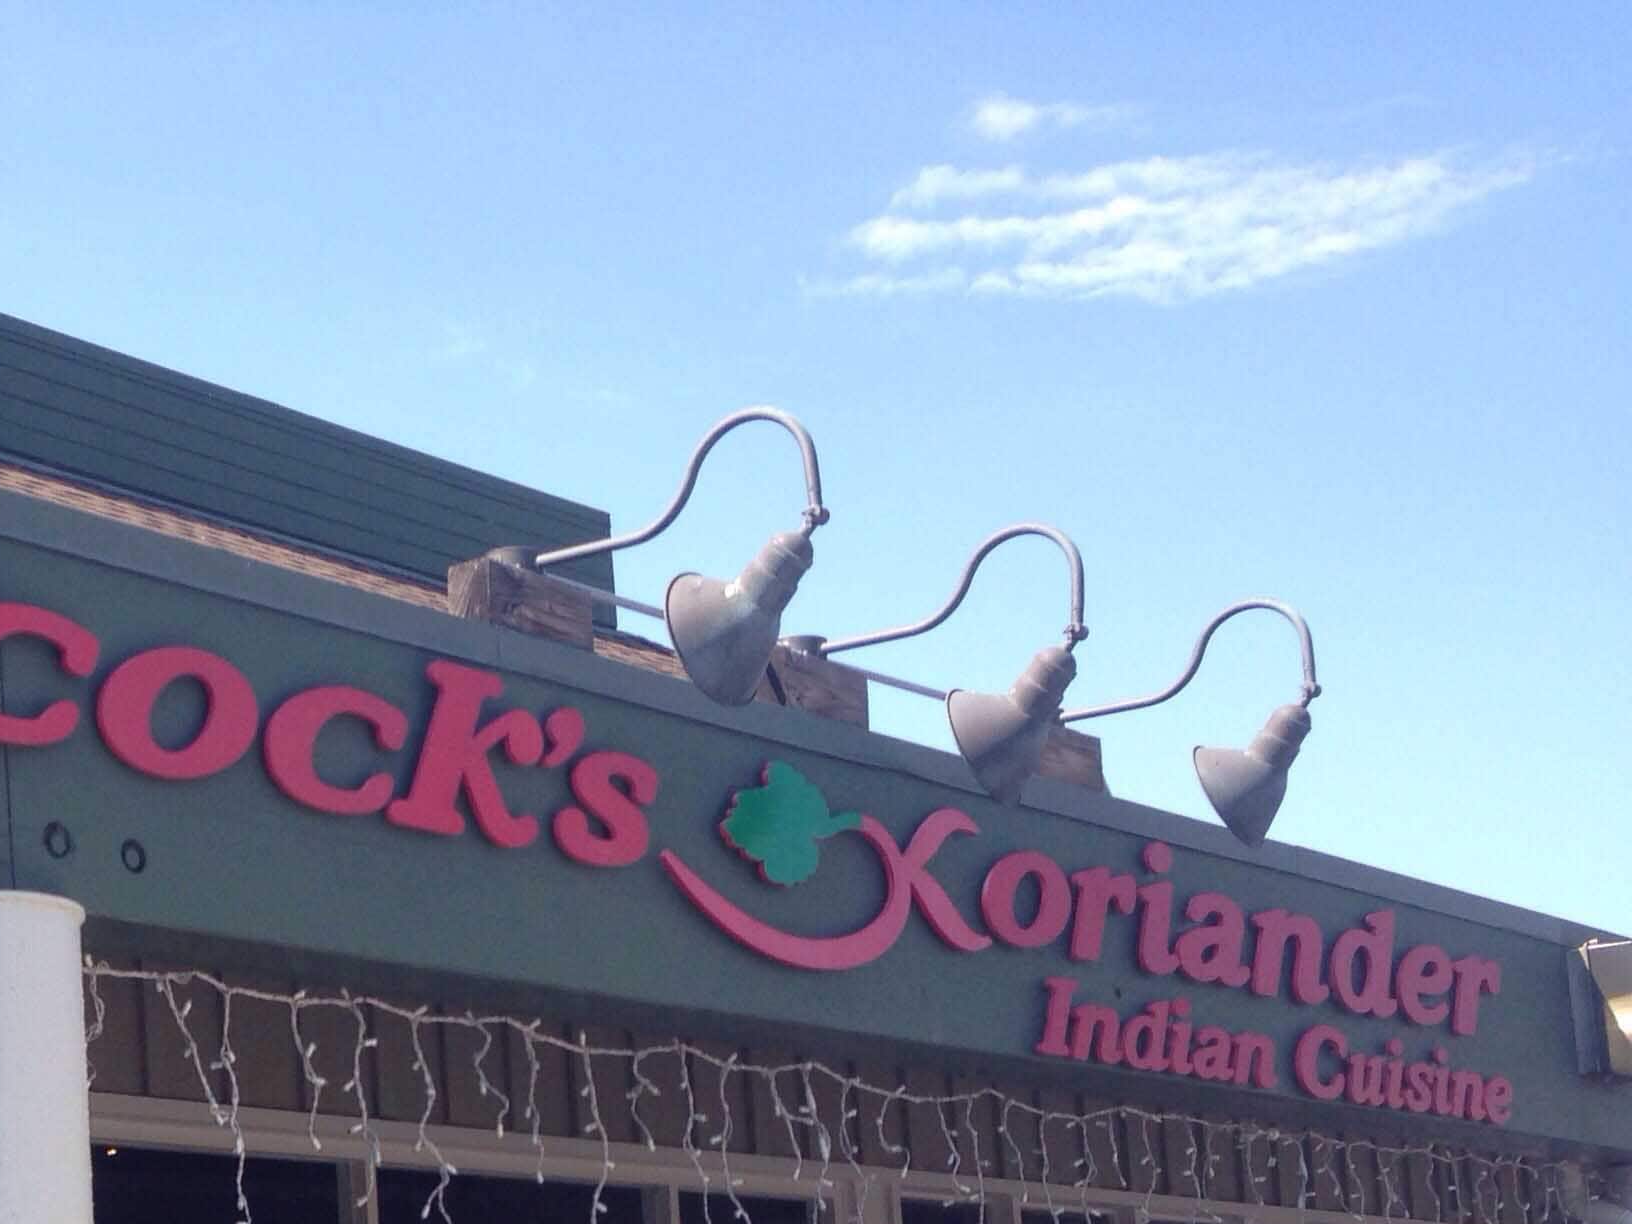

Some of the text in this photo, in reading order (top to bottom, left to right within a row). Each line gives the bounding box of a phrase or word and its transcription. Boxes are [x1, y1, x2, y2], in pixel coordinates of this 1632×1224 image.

[659, 807, 1502, 1037] Koriander
[1035, 975, 1515, 1126] Indian Cuisine
